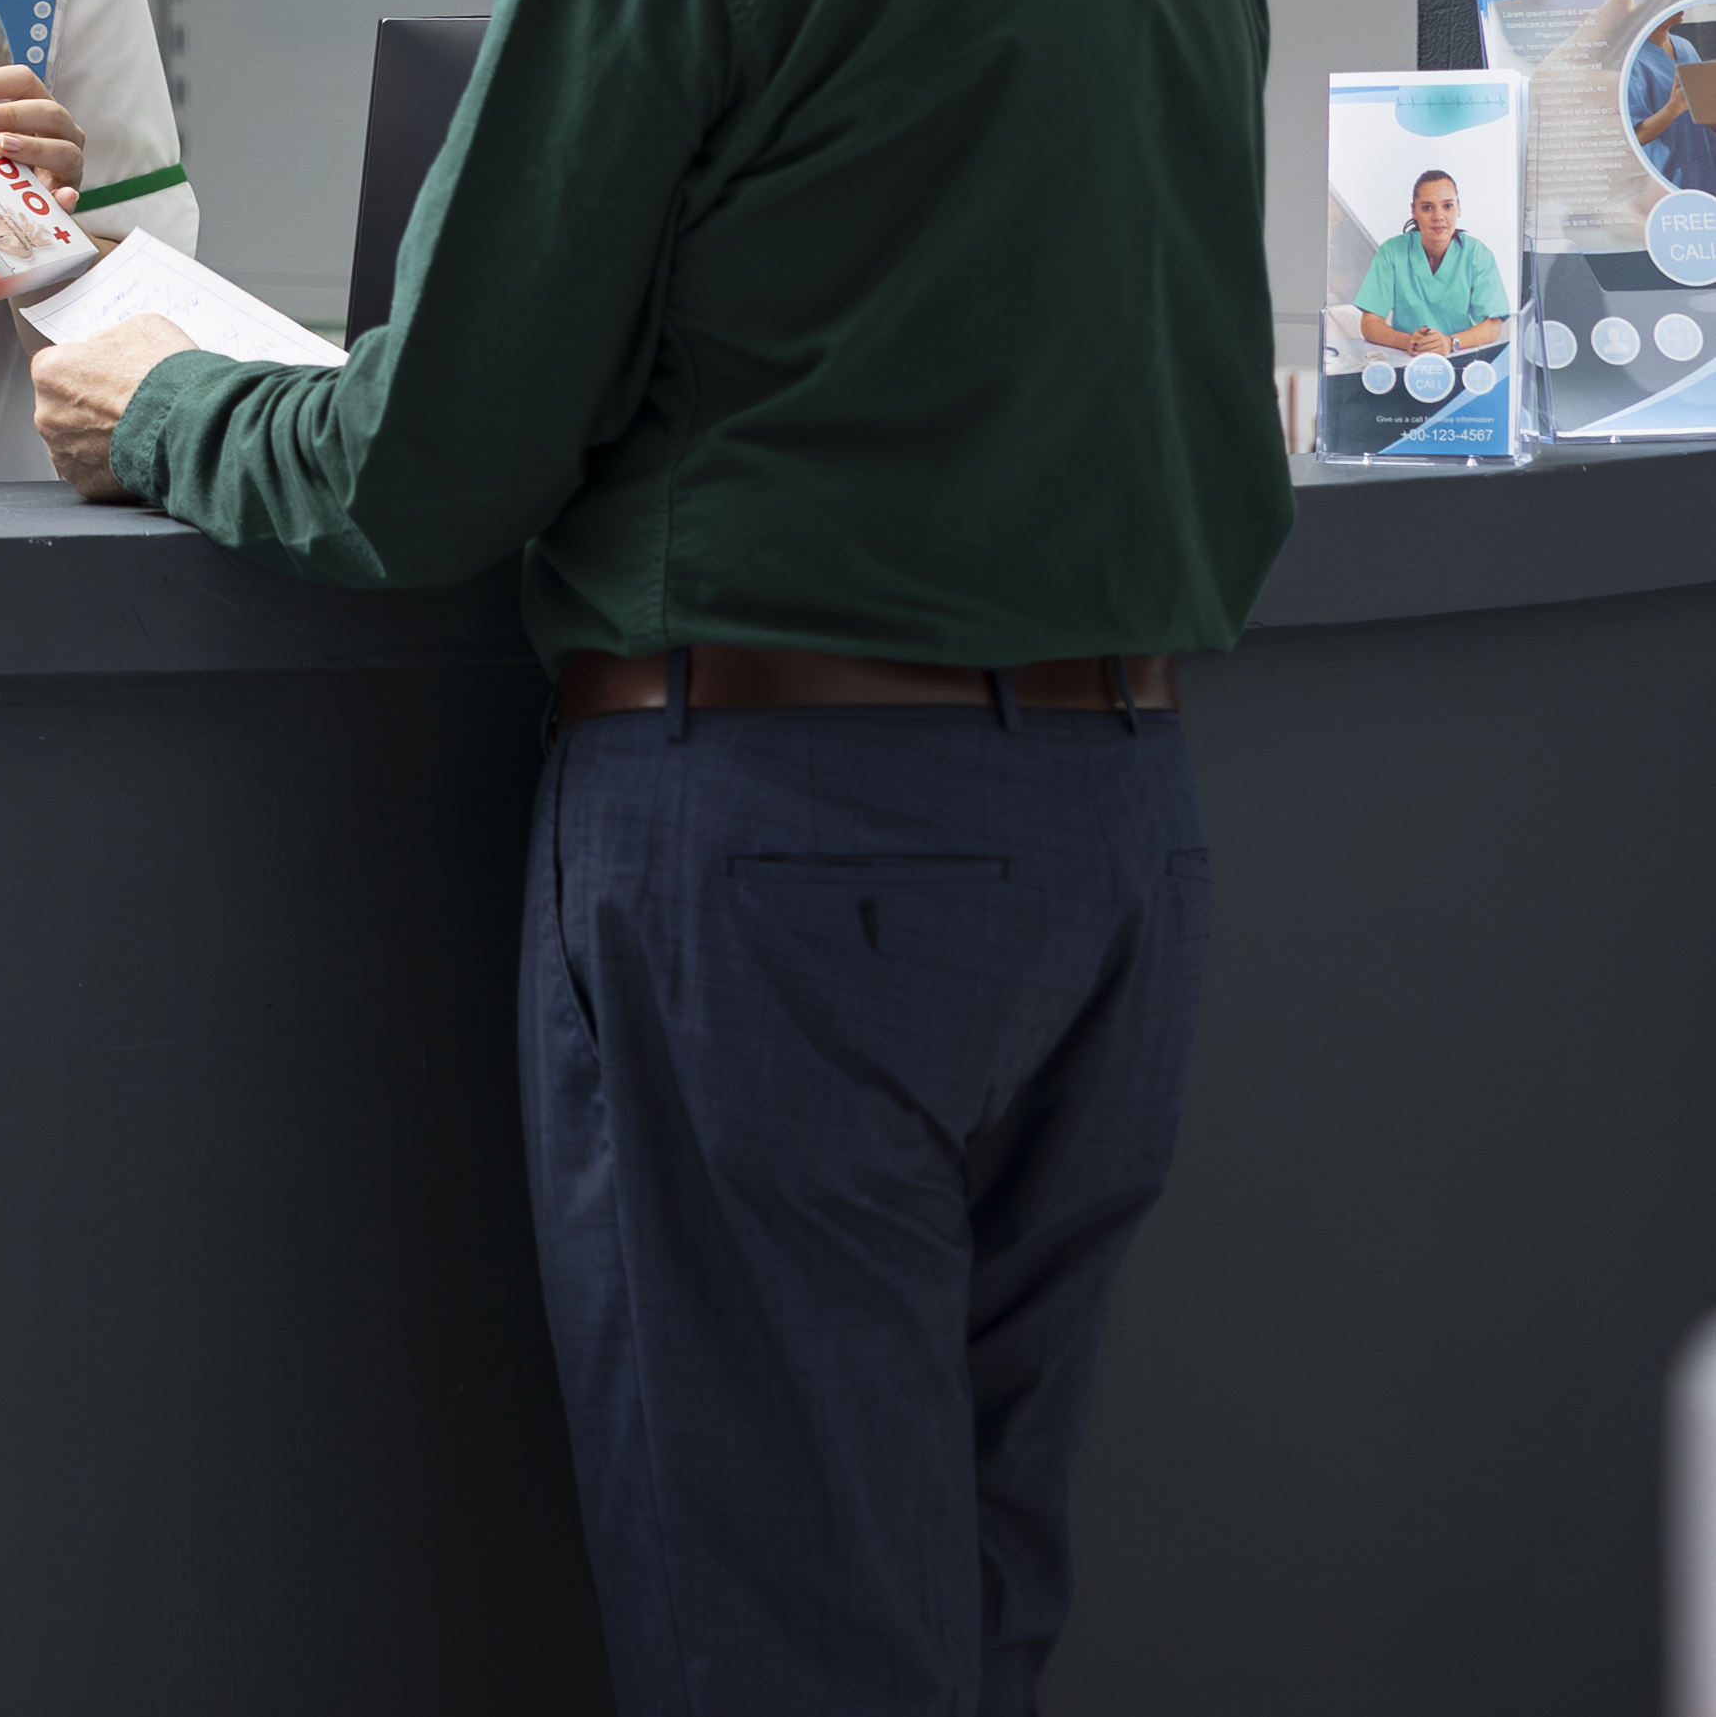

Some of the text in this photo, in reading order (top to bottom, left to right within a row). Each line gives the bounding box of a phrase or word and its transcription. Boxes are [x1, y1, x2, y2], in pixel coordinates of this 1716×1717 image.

[1661, 213, 1716, 232] FREE
[1670, 242, 1716, 262] CALL
[1413, 364, 1444, 375] FREE
[1415, 379, 1444, 390] CALL
[1376, 415, 1393, 423] Give
[1401, 428, 1493, 442] +00-123-4567
